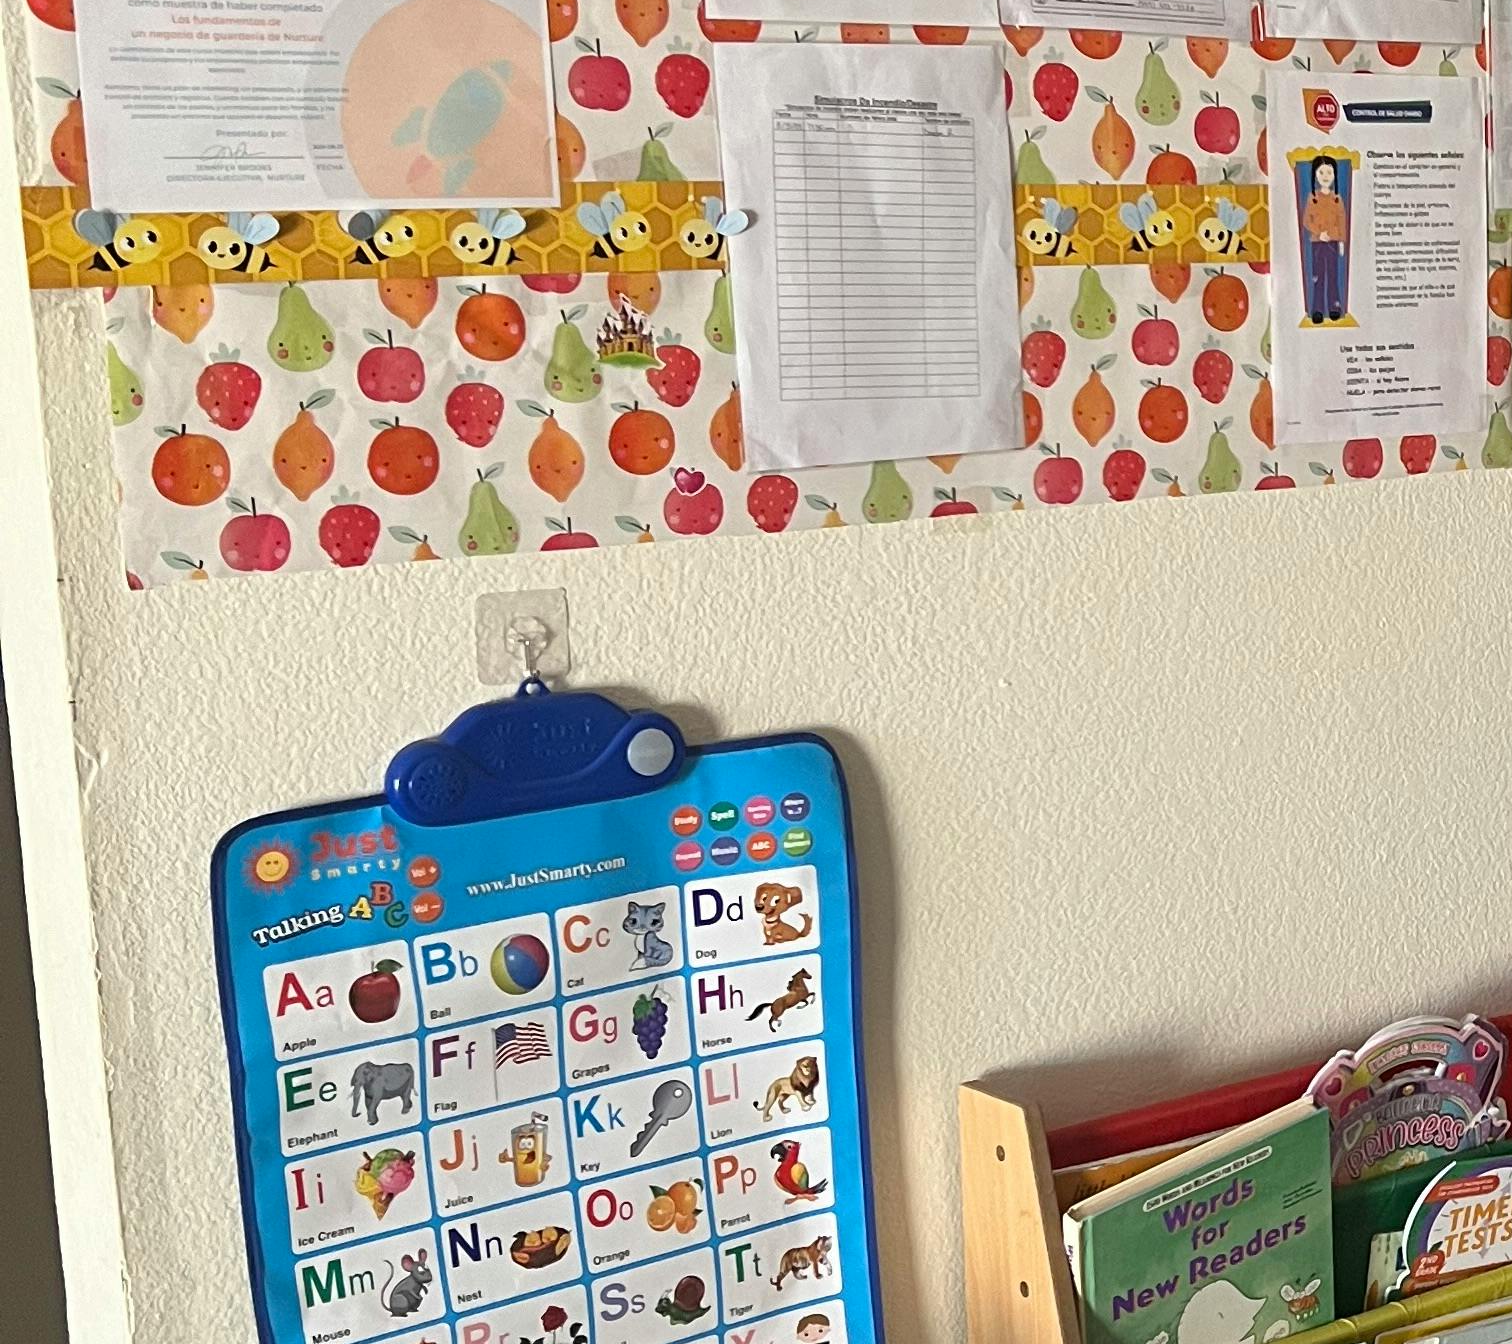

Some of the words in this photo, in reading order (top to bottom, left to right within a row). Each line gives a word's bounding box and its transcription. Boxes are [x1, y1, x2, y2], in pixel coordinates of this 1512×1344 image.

[1317, 104, 1336, 114] ALTO
[309, 825, 398, 863] Just
[466, 856, 626, 897] www.JustSmarty.com
[252, 904, 344, 948] Talking
[695, 948, 717, 960] Dog
[567, 977, 584, 989] Cat
[430, 1007, 451, 1020] Ball
[282, 1036, 317, 1053] Apple
[702, 1036, 732, 1048] Horse
[572, 1062, 610, 1079] Grapes
[433, 1100, 458, 1114] Flag
[287, 1128, 339, 1149] Elephant
[710, 1127, 733, 1140] Lion
[580, 1162, 601, 1173] Key
[445, 1194, 474, 1209] Juice
[1163, 1177, 1256, 1233] Words
[720, 1213, 751, 1229] Parrot
[298, 1235, 315, 1248] Ice
[318, 1226, 355, 1242] Cream
[1190, 1218, 1230, 1251] for
[593, 1248, 630, 1266] Orange
[1112, 1274, 1179, 1323] New
[1189, 1213, 1307, 1285] Readers
[457, 1290, 482, 1304] Nest
[730, 1304, 753, 1317] Tiger
[312, 1328, 351, 1344] Mouse
